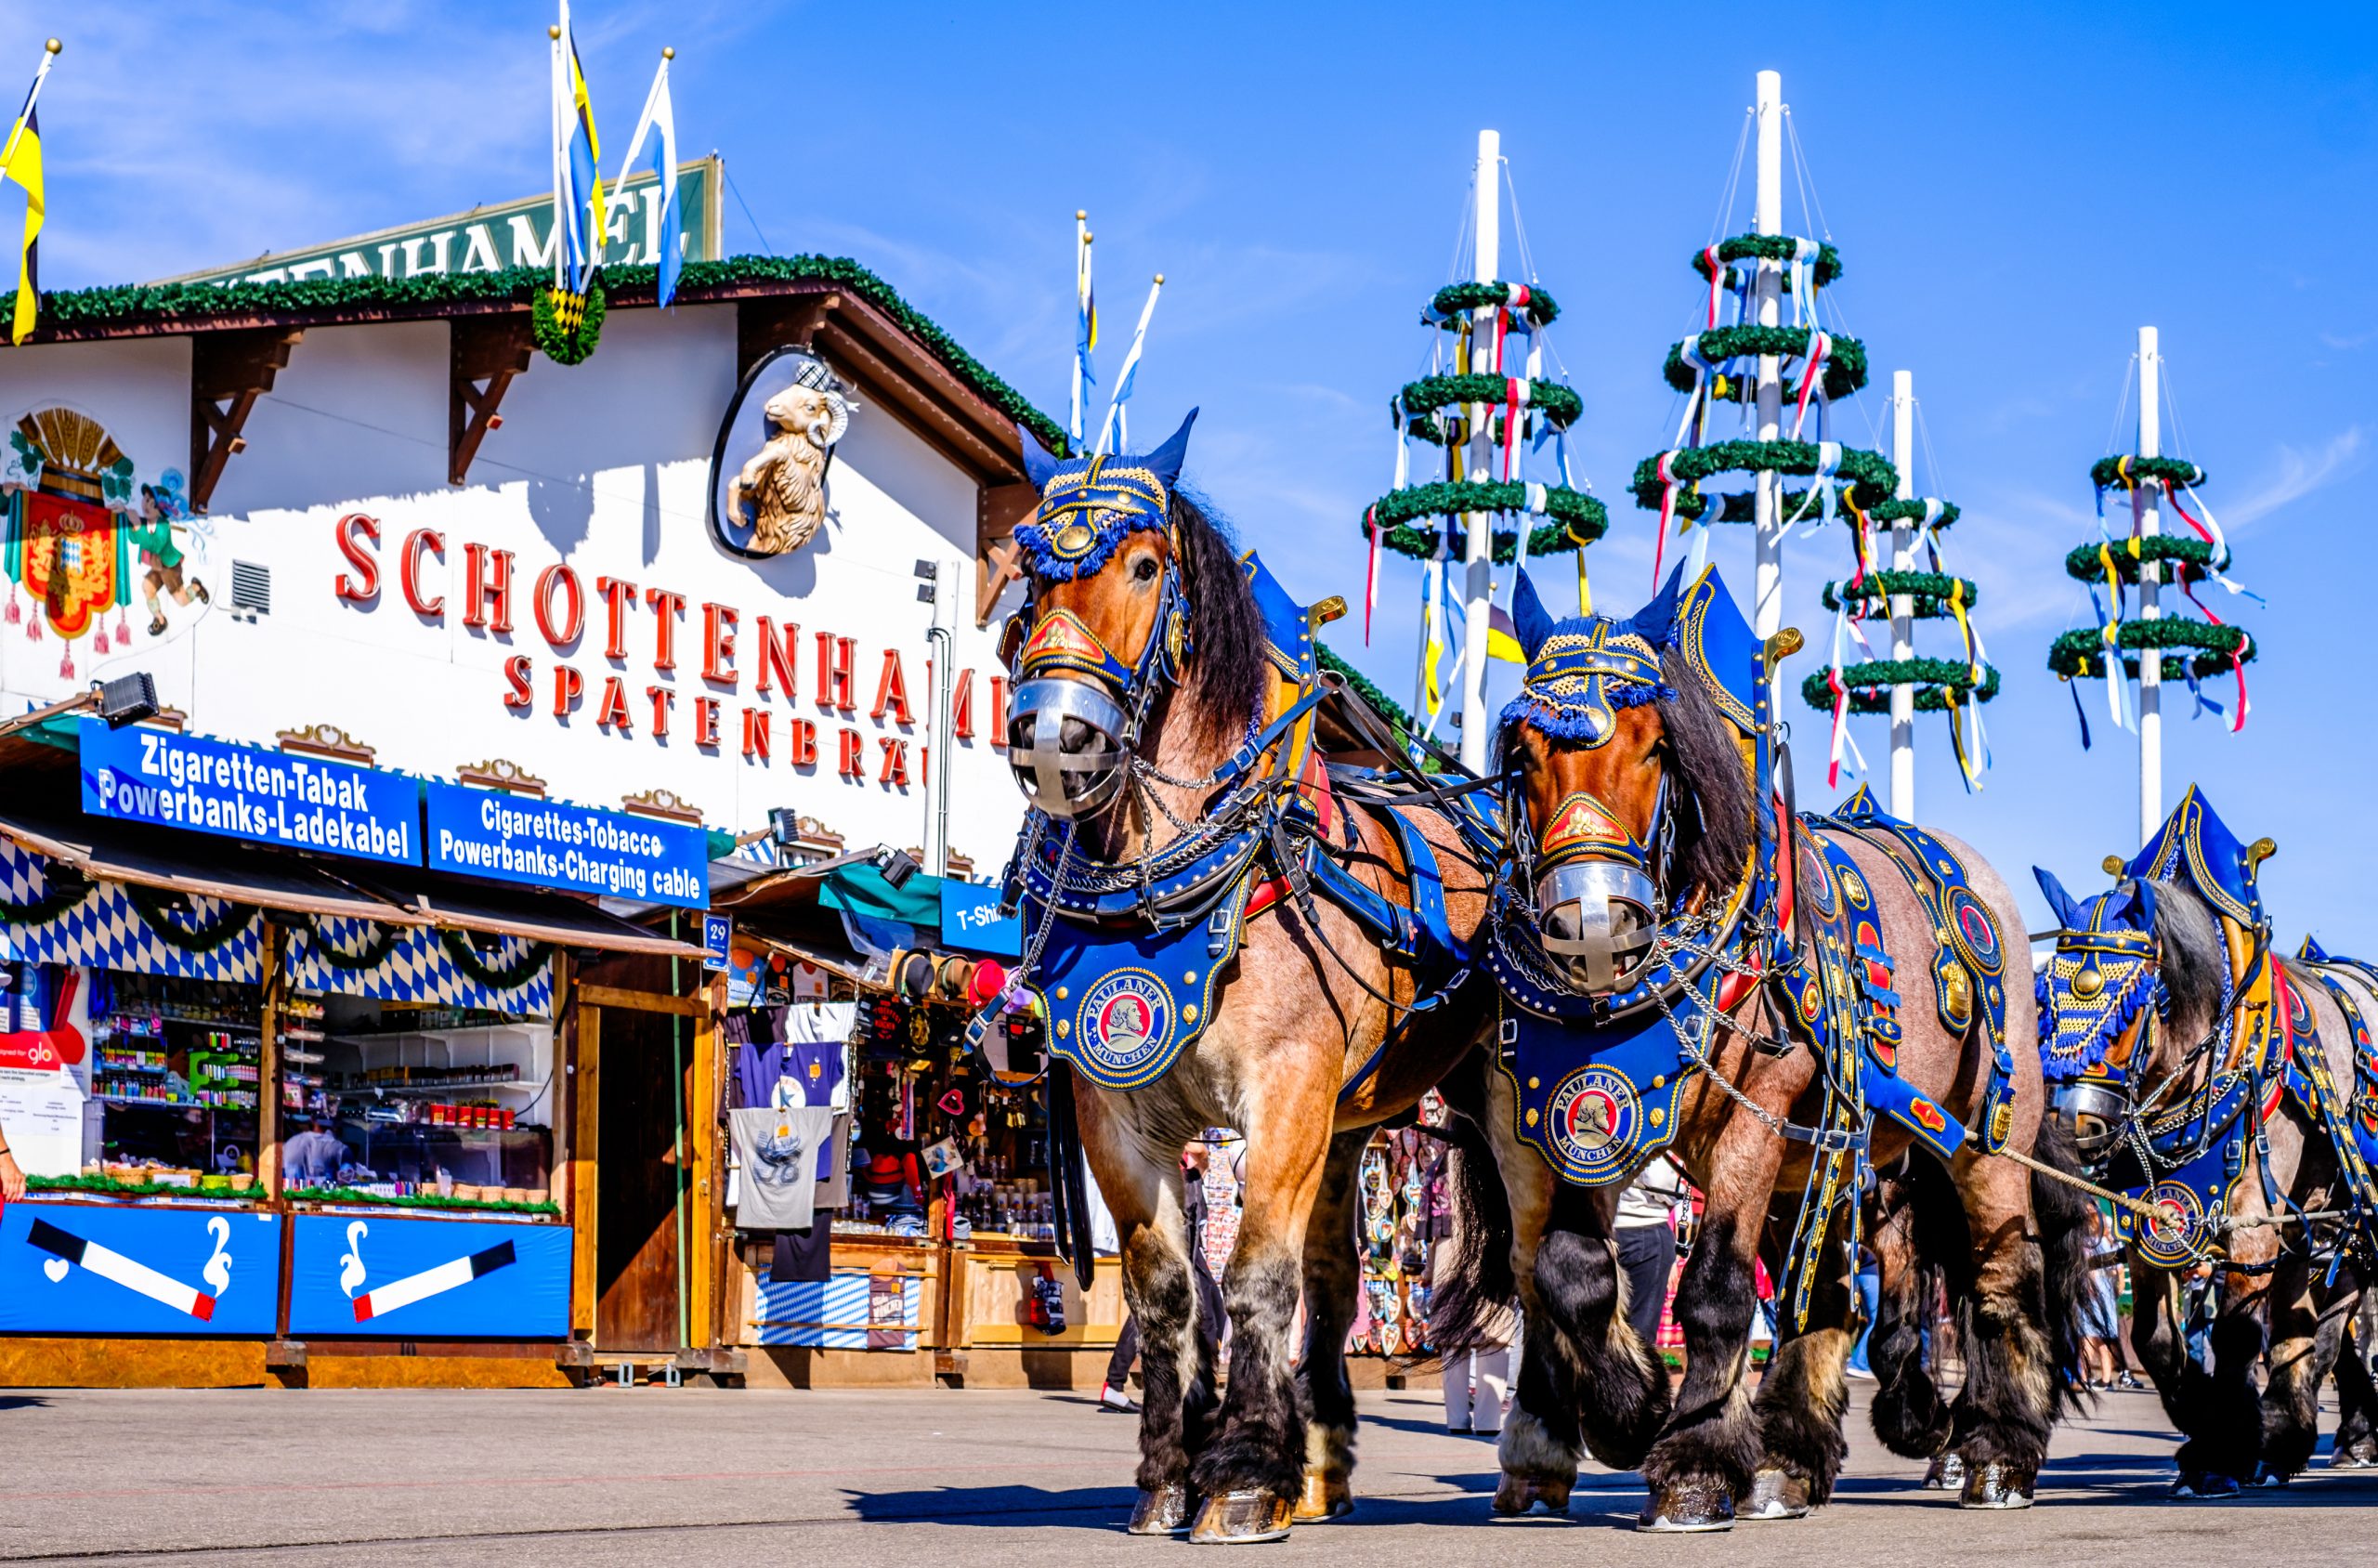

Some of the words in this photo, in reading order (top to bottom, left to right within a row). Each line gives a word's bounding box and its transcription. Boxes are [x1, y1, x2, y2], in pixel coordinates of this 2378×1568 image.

[503, 654, 929, 788] SPATENBRÄ
[140, 734, 369, 813] Zigaretten-Tabak
[98, 767, 409, 859] Powerbanks-Ladekabel
[481, 797, 662, 858] Cigarettes-Tobacco
[440, 829, 647, 897] Powerbanks-Charging
[652, 868, 700, 899] cable
[710, 923, 726, 941] 29
[1088, 978, 1162, 1018] PAULANER
[28, 1041, 53, 1065] glo
[1092, 1036, 1158, 1065] MÜNCHEN
[1555, 1075, 1630, 1112] PAULANER
[1559, 1135, 1624, 1161] MÜNCHEN
